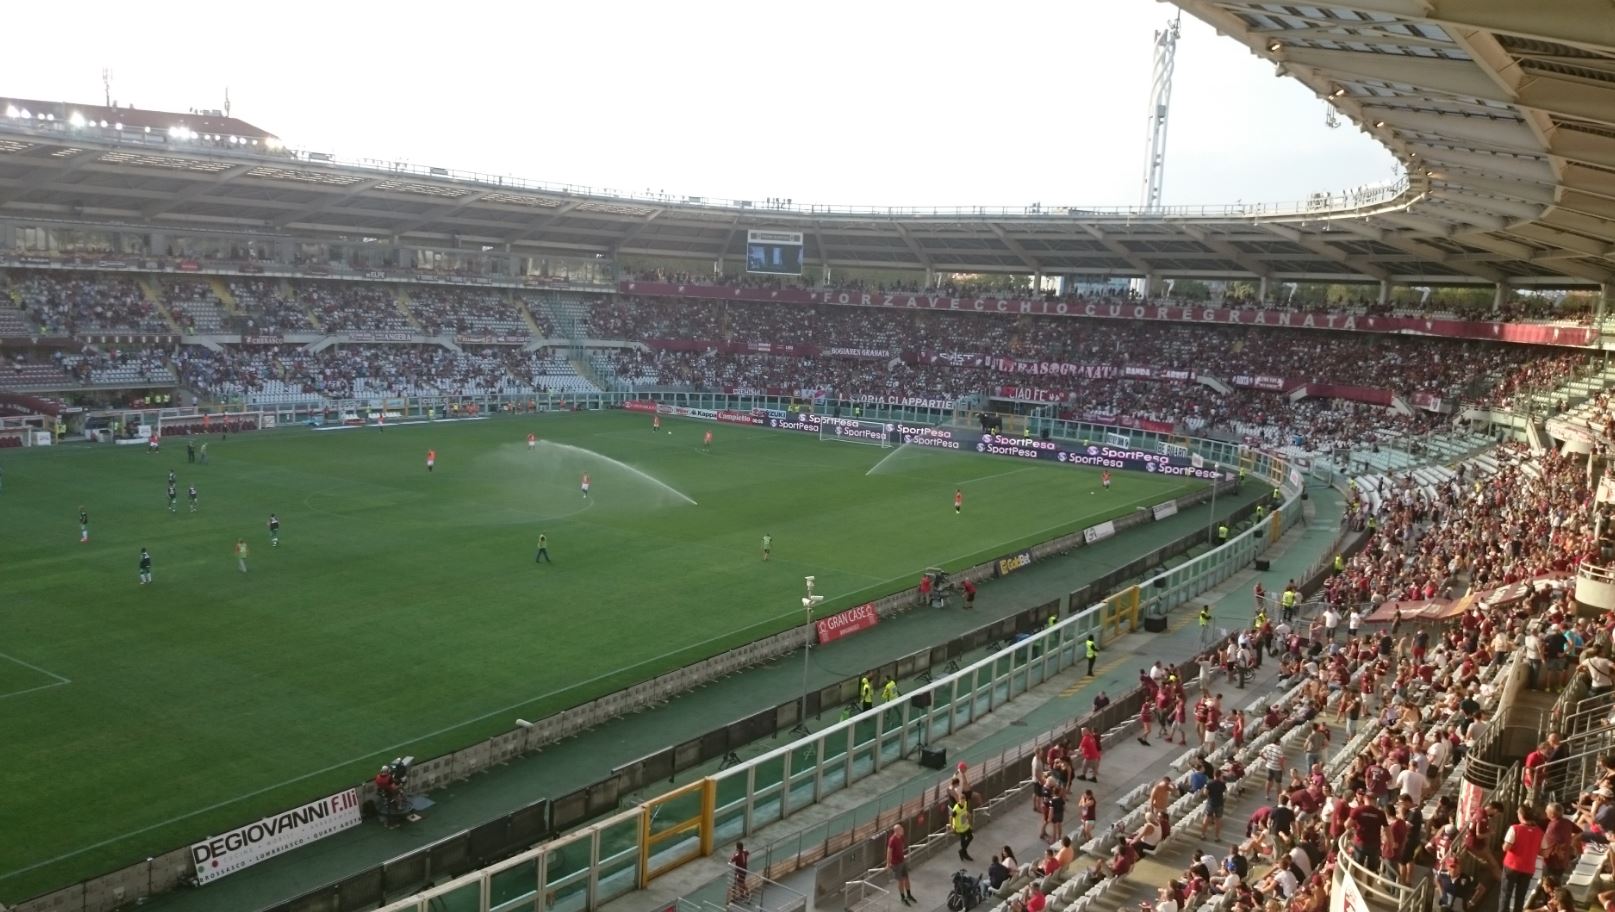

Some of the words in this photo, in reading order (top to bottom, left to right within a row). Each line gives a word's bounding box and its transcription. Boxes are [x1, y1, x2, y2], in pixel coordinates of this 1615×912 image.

[697, 410, 717, 419] Kappa
[808, 414, 859, 428] SportPesa
[779, 419, 819, 432] SportPesa
[843, 426, 887, 440] SportPesa
[896, 424, 951, 438] SportPesa
[913, 436, 959, 449] SportPesa
[994, 434, 1055, 450] SportPesa
[986, 443, 1038, 458] SportPesa
[1101, 447, 1170, 465] SportPesa
[1068, 453, 1124, 468] SportPesa
[1158, 463, 1217, 479] SportPesa
[827, 612, 849, 630] GRAN
[848, 606, 866, 622] CASE
[191, 800, 330, 865] DEGIOVANNI
